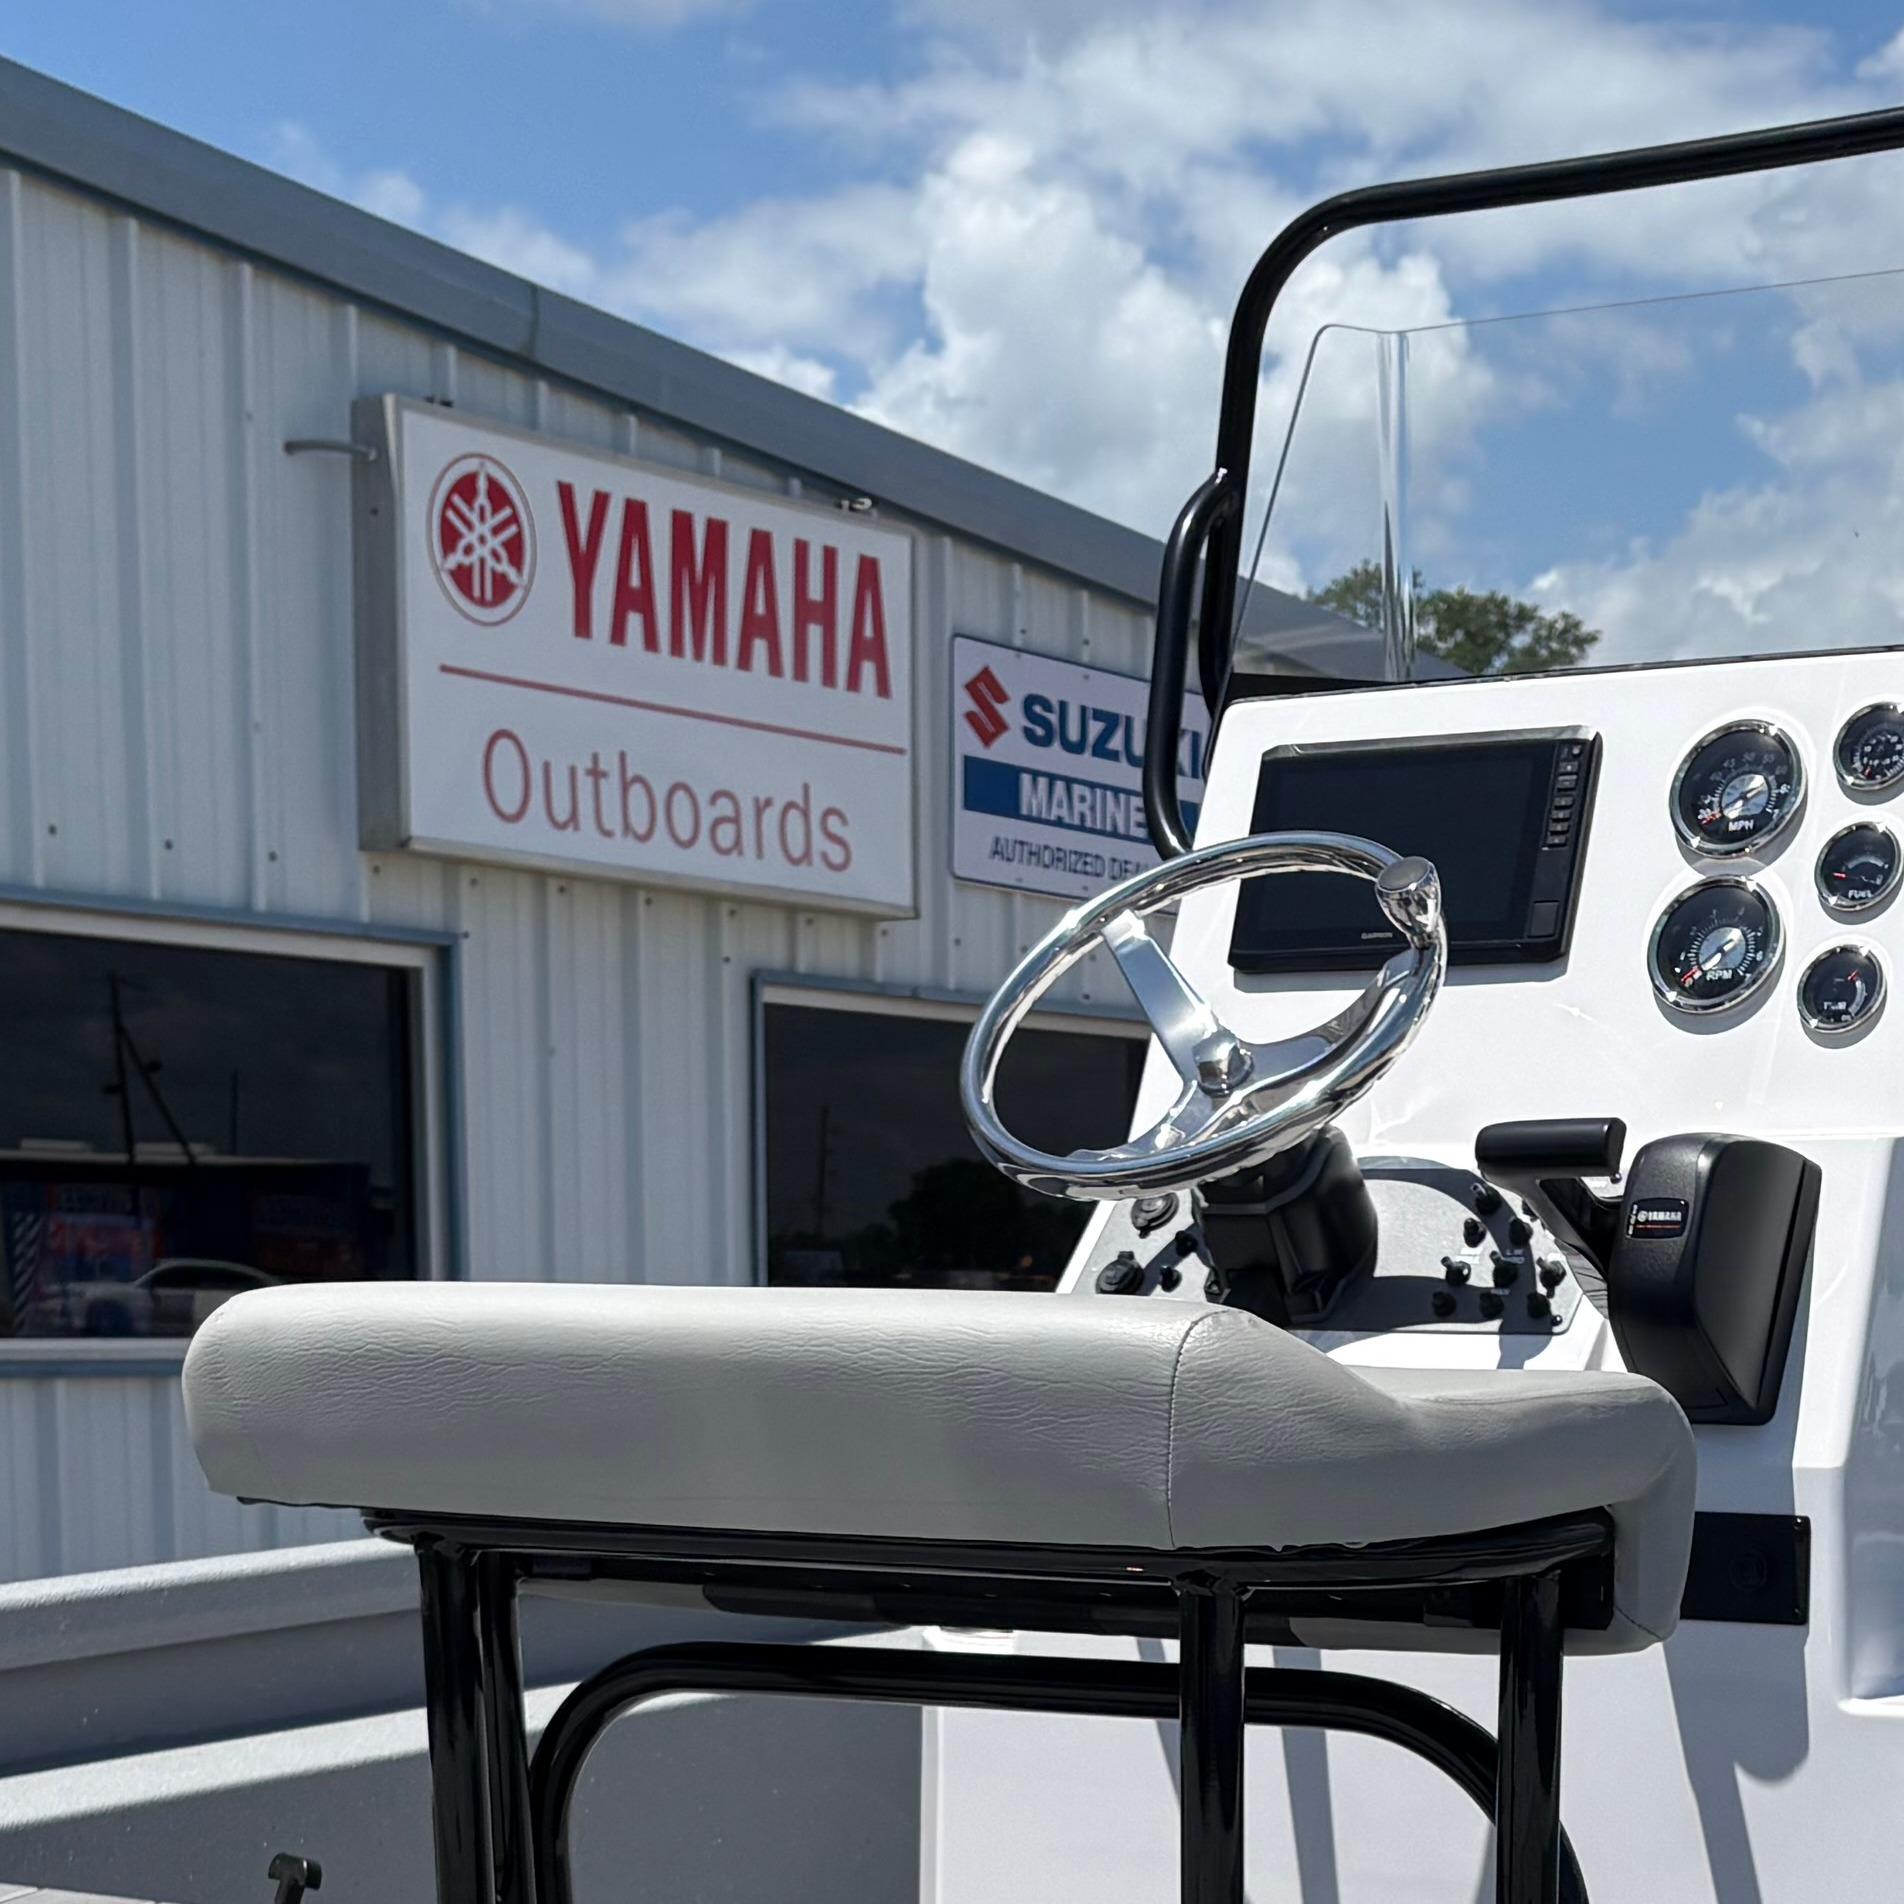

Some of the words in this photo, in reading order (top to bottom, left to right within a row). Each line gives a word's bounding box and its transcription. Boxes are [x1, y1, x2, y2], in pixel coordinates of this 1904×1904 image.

[555, 479, 893, 700] YAMAHA
[482, 727, 856, 873] Outboards
[1018, 771, 1148, 837] MARINE
[1727, 819, 1754, 832] MPH
[990, 835, 1105, 878] AUTHORIZED
[1848, 889, 1873, 899] FUEL
[1706, 969, 1733, 982] RPM
